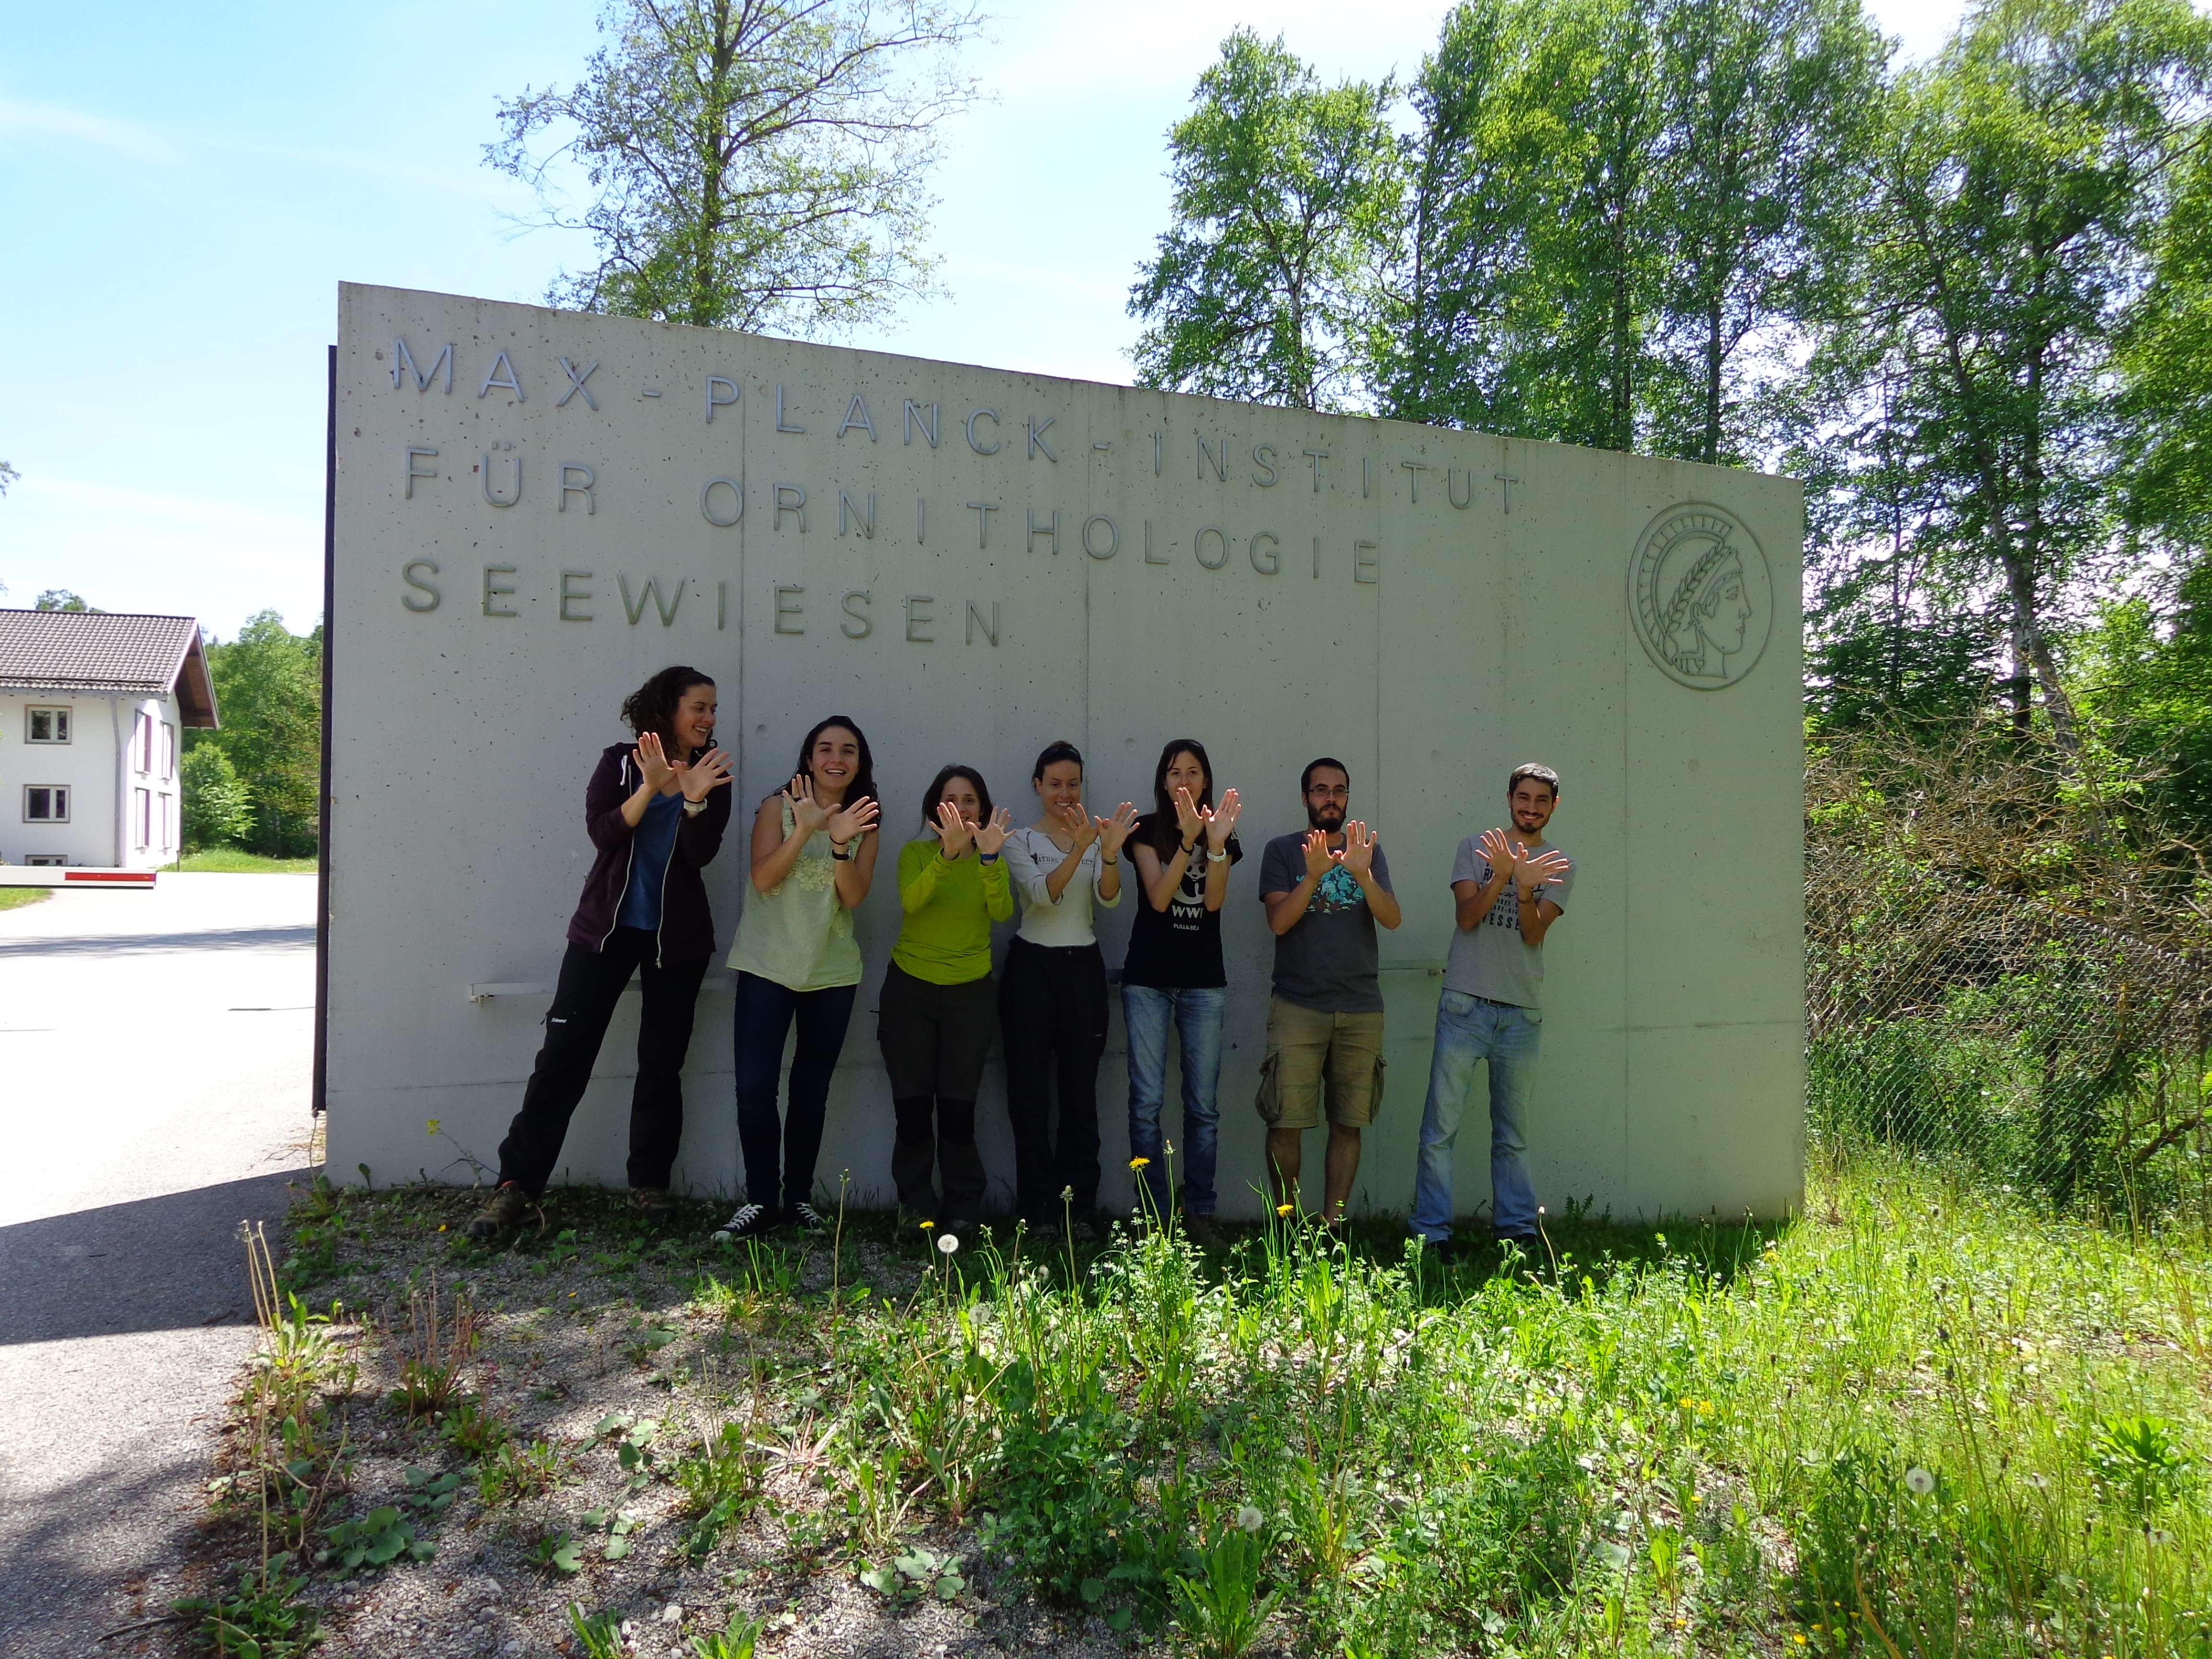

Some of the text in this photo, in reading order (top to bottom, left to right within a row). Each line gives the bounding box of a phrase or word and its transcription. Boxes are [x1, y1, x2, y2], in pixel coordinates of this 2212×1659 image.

[405, 441, 1377, 584] FÜR ORNITHOLOGIE
[401, 558, 998, 647] SEEWIESEN
[1482, 913, 1519, 930] ESSE
